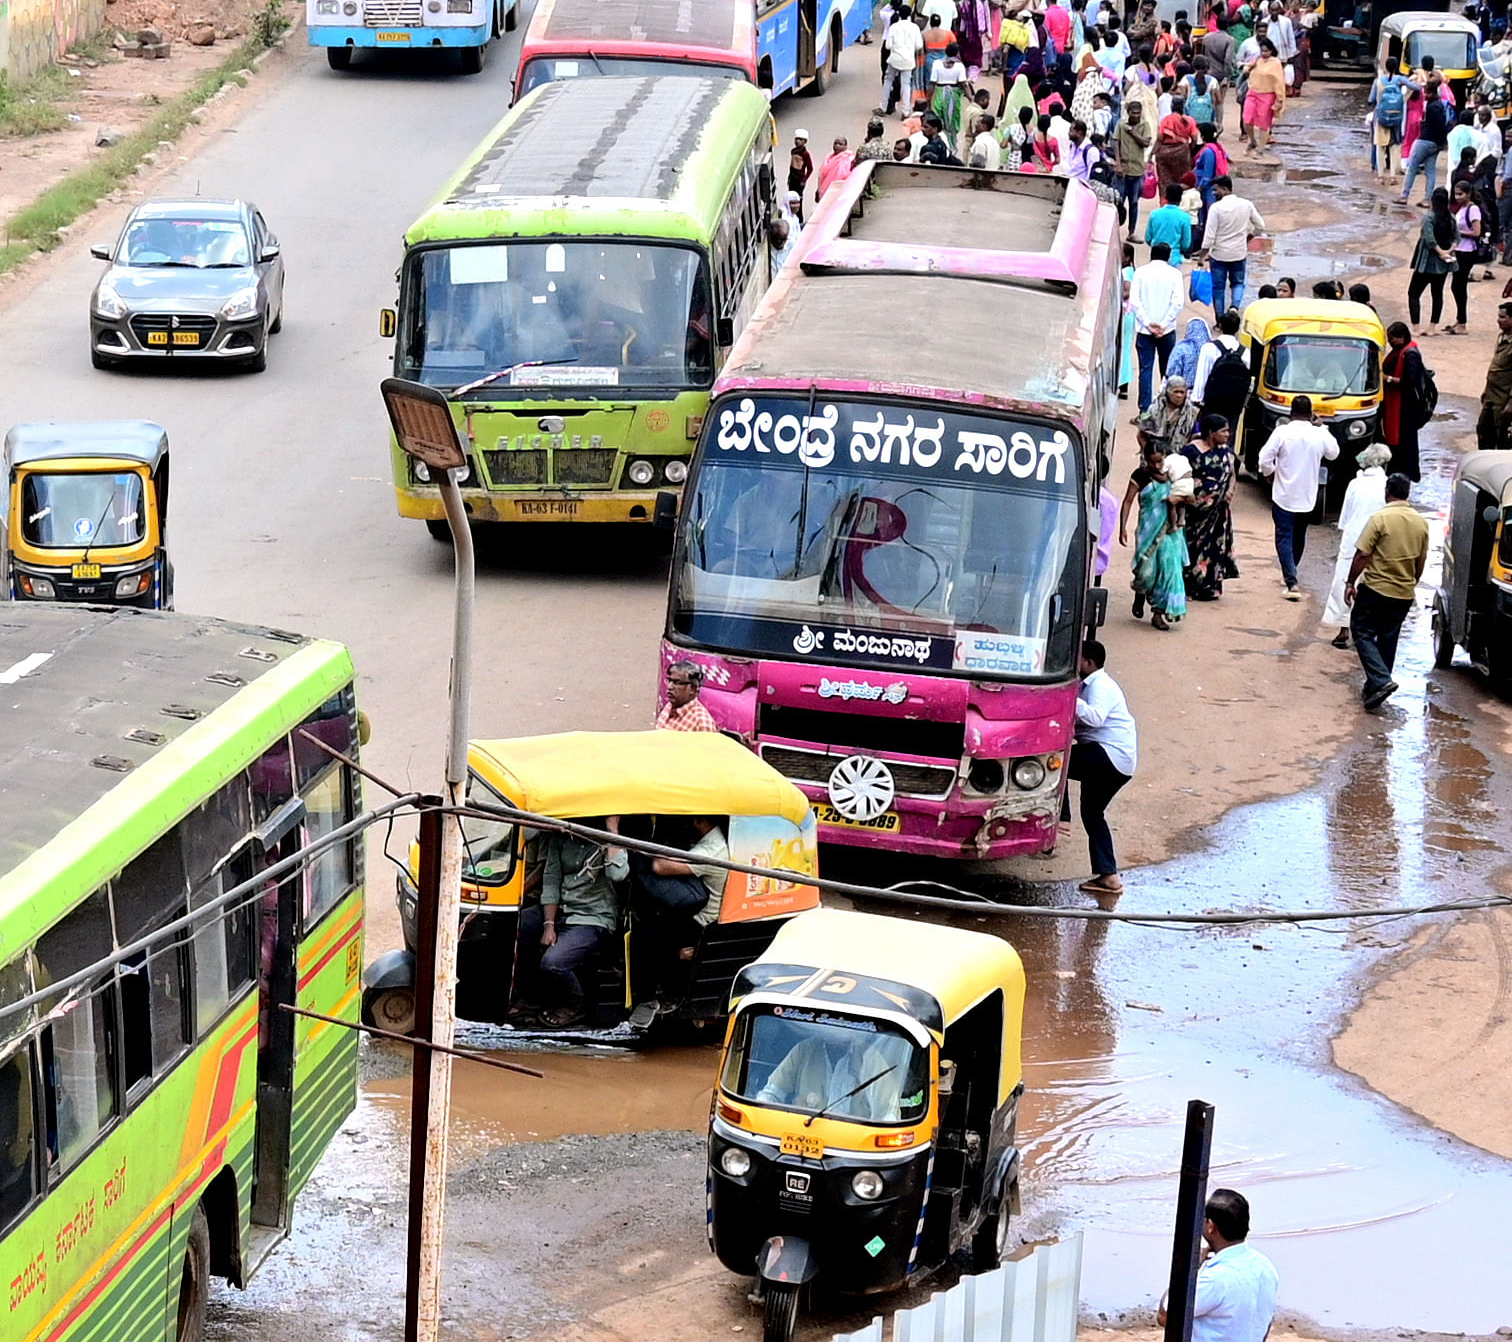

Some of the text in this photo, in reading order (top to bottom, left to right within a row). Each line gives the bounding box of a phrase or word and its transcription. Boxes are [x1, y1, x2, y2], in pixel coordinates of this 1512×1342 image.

[498, 434, 603, 450] EICHER
[717, 398, 1069, 484] ಬೇಂದ್ರೆ ನಗರ ಸಾರಿಗೆ
[793, 625, 932, 663] ಶ್ರೀ ಮಂಜುನಾಥ
[790, 1179, 805, 1189] RE
